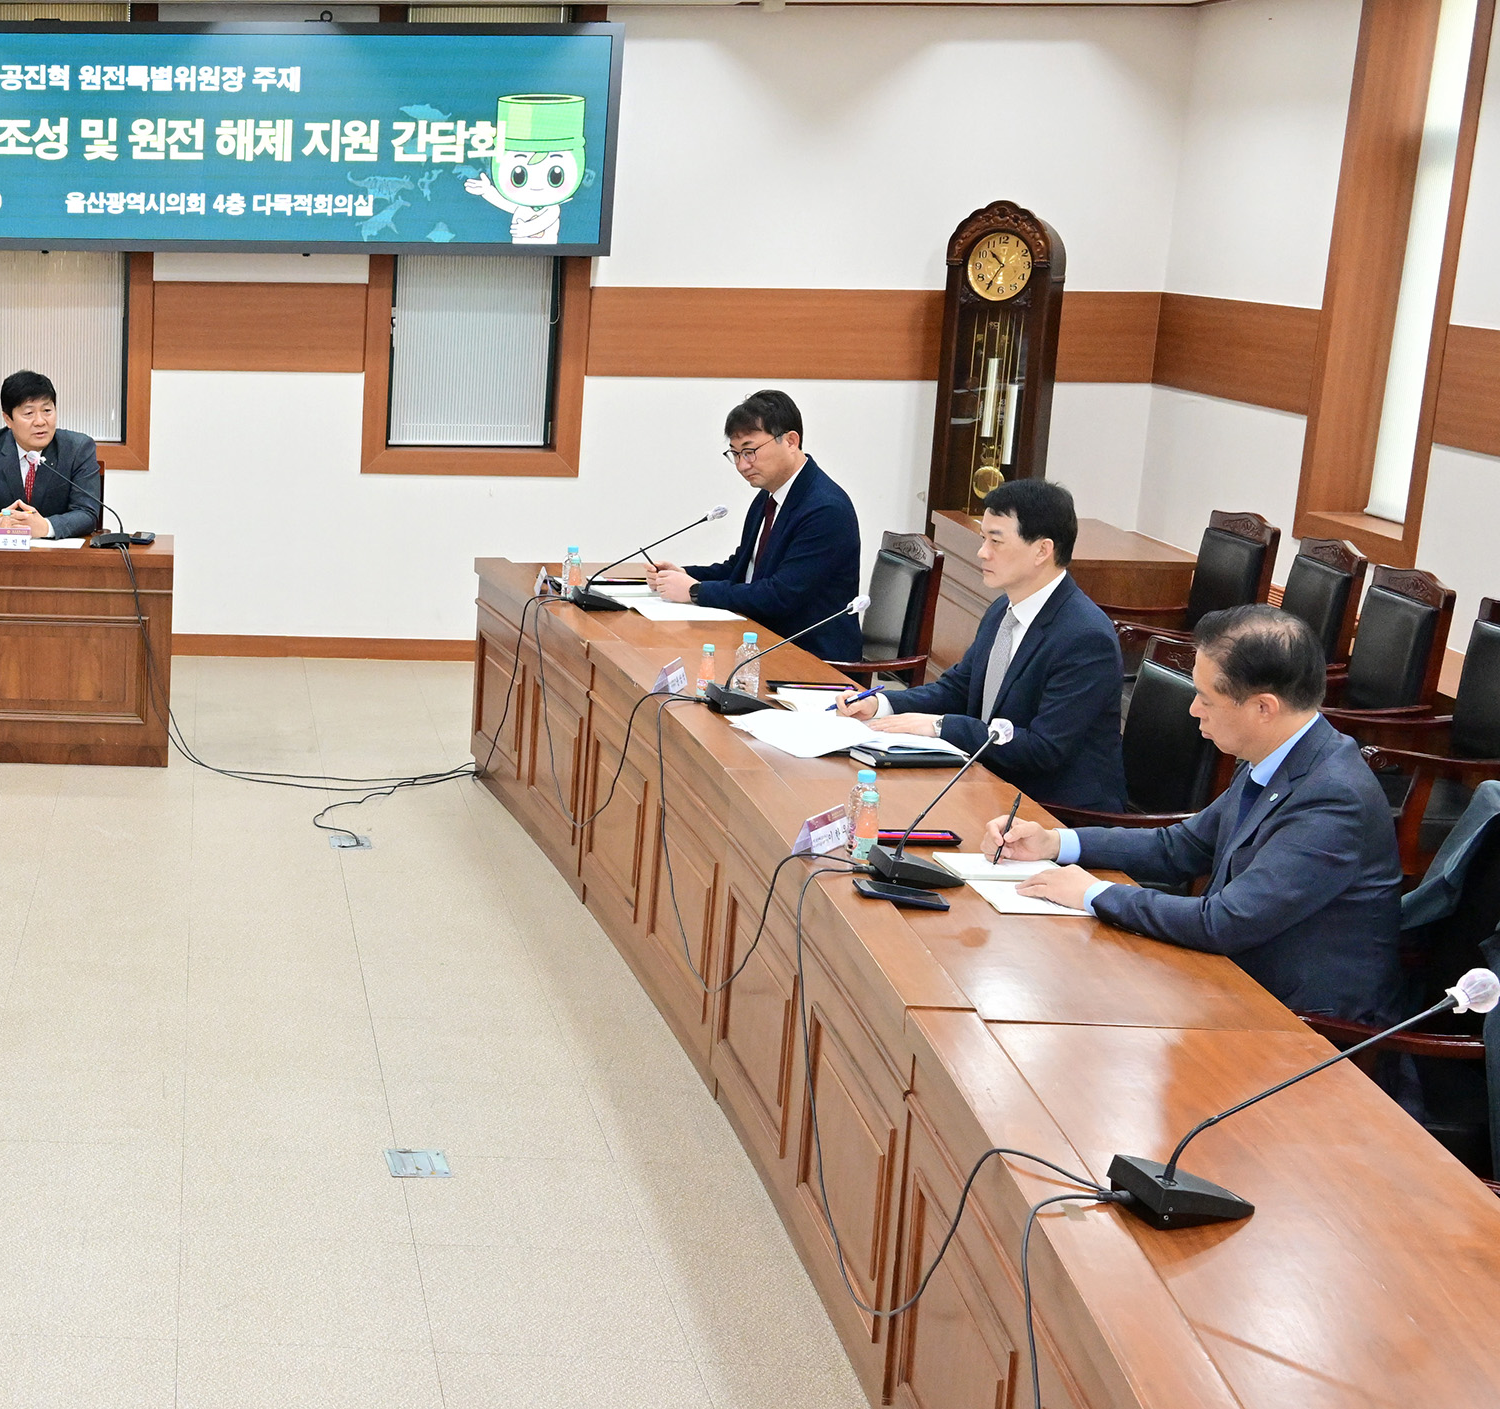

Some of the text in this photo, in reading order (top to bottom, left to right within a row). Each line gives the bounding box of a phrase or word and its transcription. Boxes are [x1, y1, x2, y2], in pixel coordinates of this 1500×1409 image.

[0, 64, 70, 91] 공진혁
[78, 65, 246, 93] 원전특별위원장
[252, 66, 301, 93] 주재
[81, 117, 119, 161] 및
[128, 118, 205, 161] 원전
[215, 118, 293, 162] 해체
[301, 119, 380, 163] 지원
[390, 120, 506, 163] 간담회
[64, 191, 374, 217] 울산광역시의회 4층 다목적회의실
[987, 240, 996, 248] 11
[999, 236, 1009, 244] 12
[1015, 240, 1019, 248] 1
[979, 250, 988, 258] 10
[1021, 249, 1028, 257] 2
[975, 262, 982, 270] 9
[1023, 261, 1030, 269] 3
[997, 286, 1004, 294] 6
